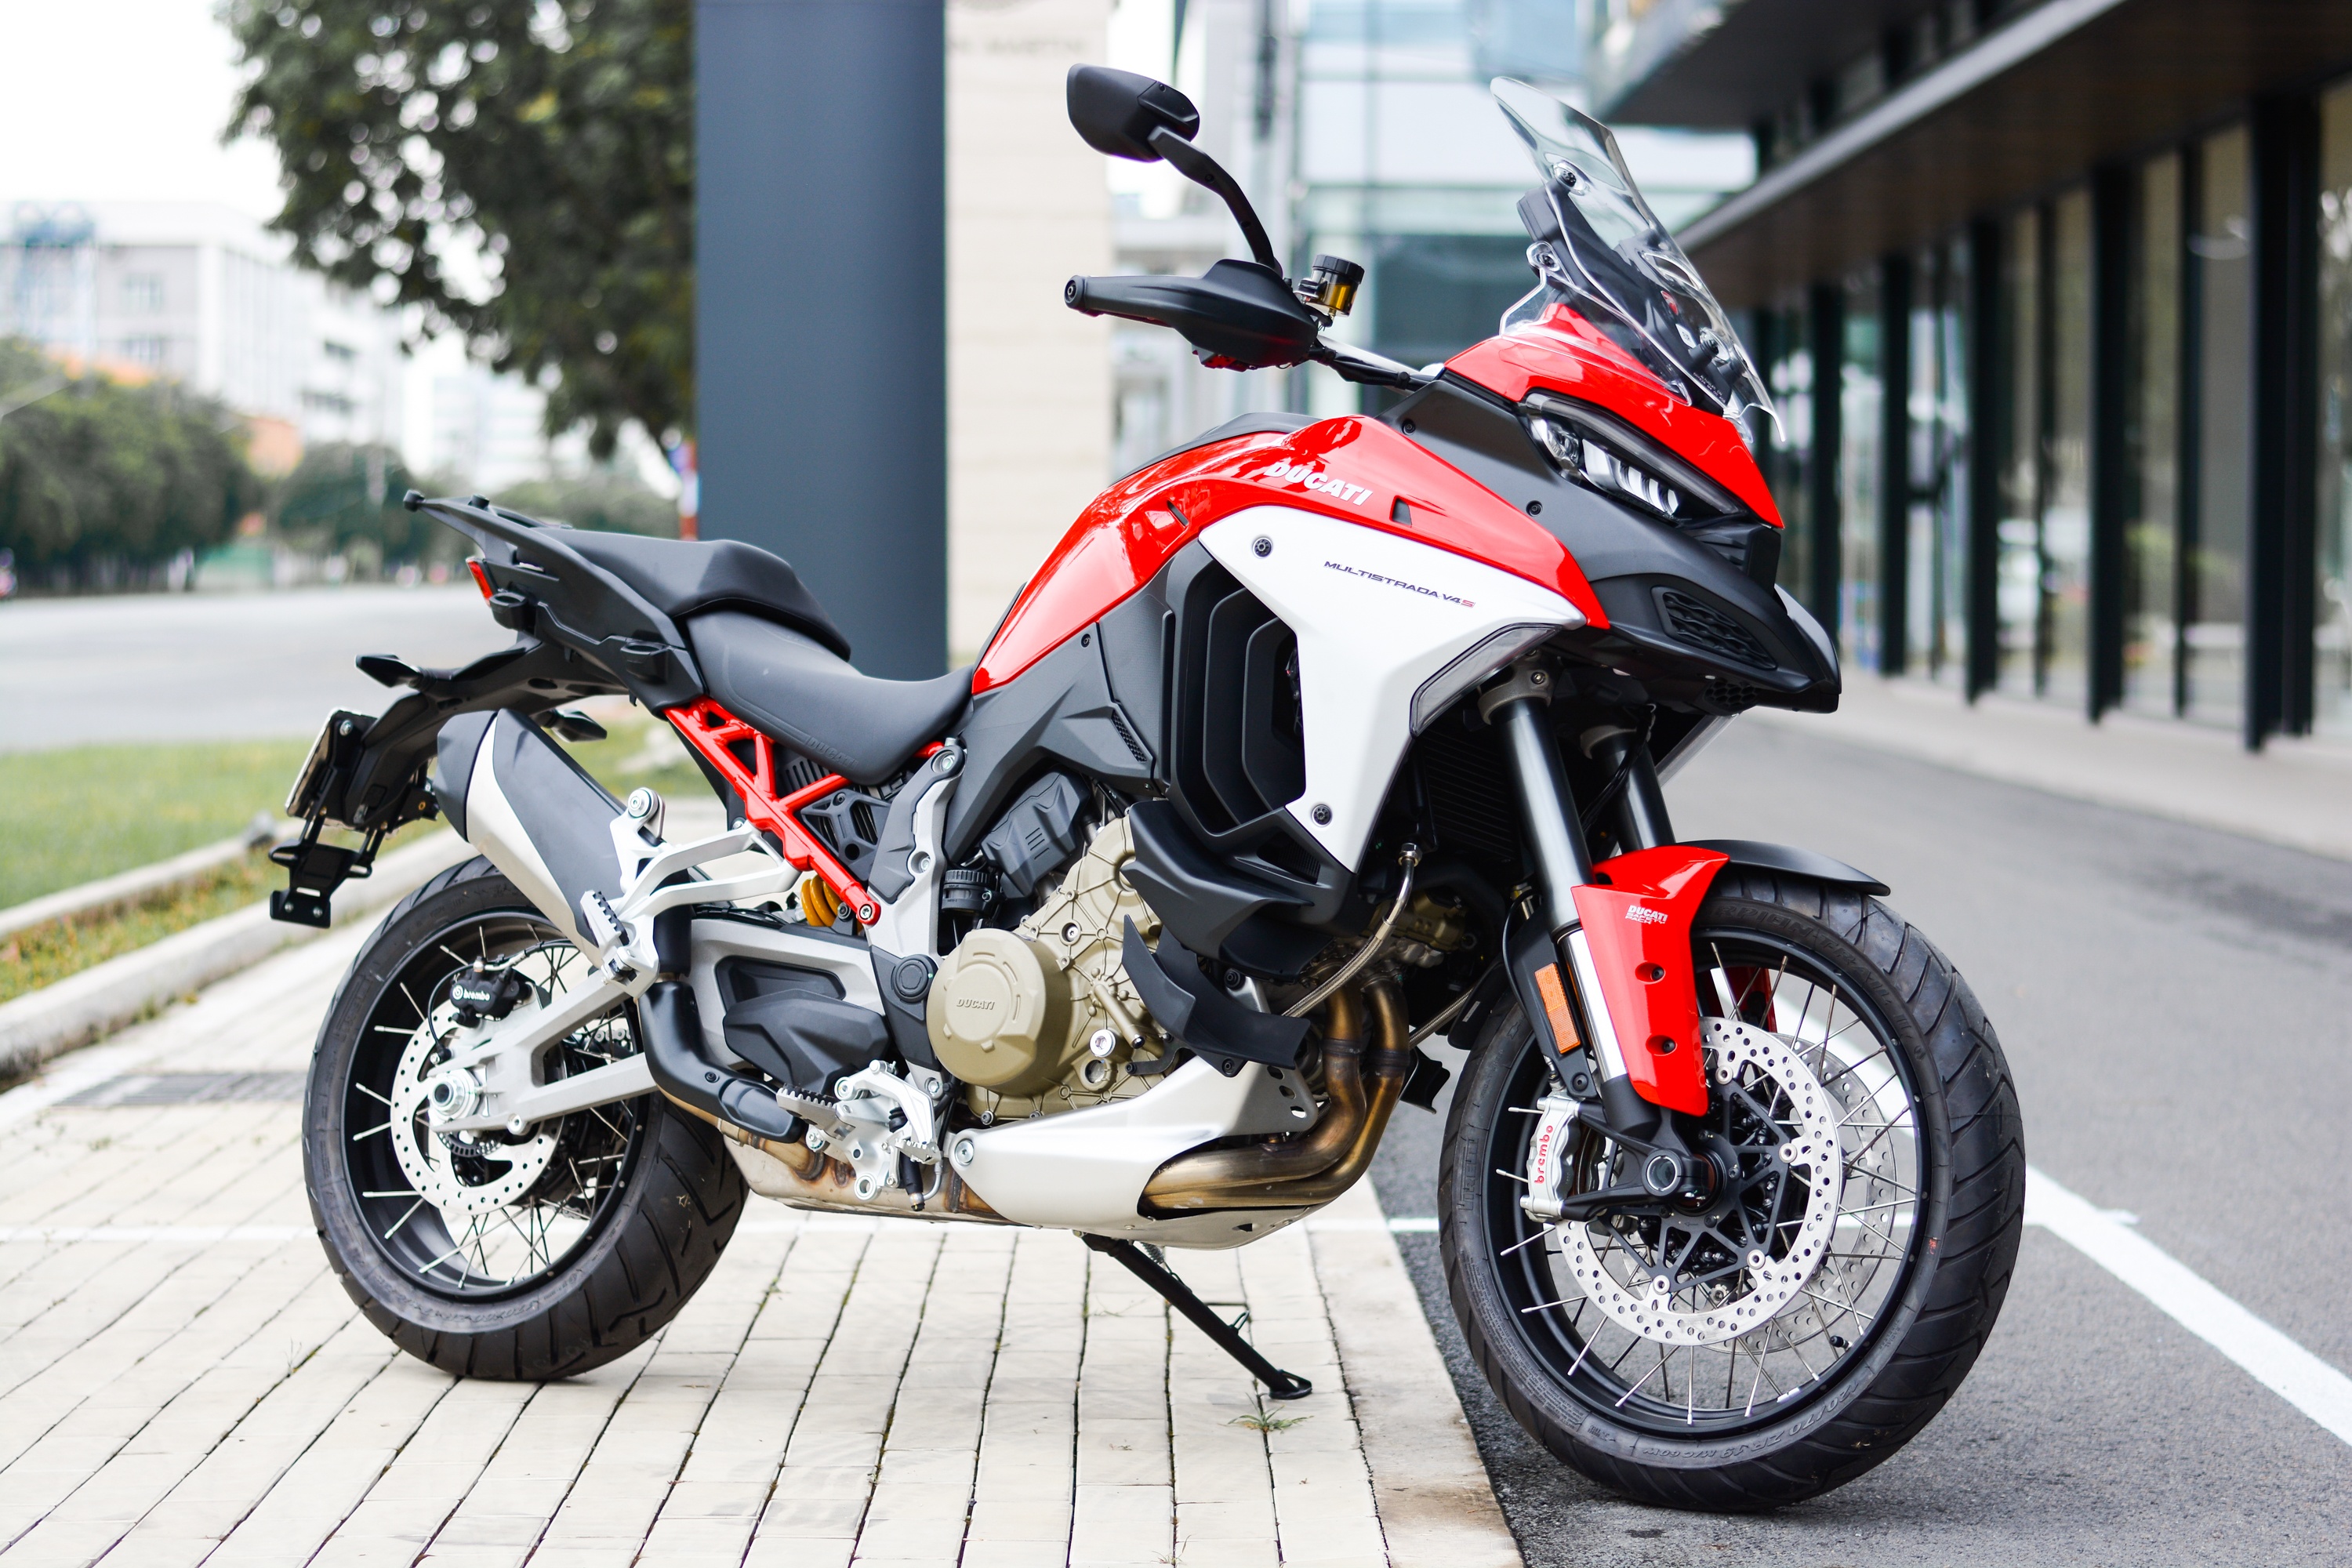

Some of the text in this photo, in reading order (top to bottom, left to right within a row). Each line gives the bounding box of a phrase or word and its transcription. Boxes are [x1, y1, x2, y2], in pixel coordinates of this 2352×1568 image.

[1264, 462, 1373, 506] DUCATI
[1324, 561, 1475, 608] MULTISTRADA V4S
[805, 735, 858, 768] DUCATI
[1627, 905, 1668, 923] DUCATI
[463, 990, 490, 1000] brembo
[956, 998, 995, 1010] DUCATI
[1534, 1125, 1554, 1184] brembo
[1458, 1138, 1479, 1210] PIRELLI
[1789, 1380, 1859, 1436] 120/70
[1720, 1444, 1748, 1458] 19
[1751, 1430, 1784, 1451] ZR
